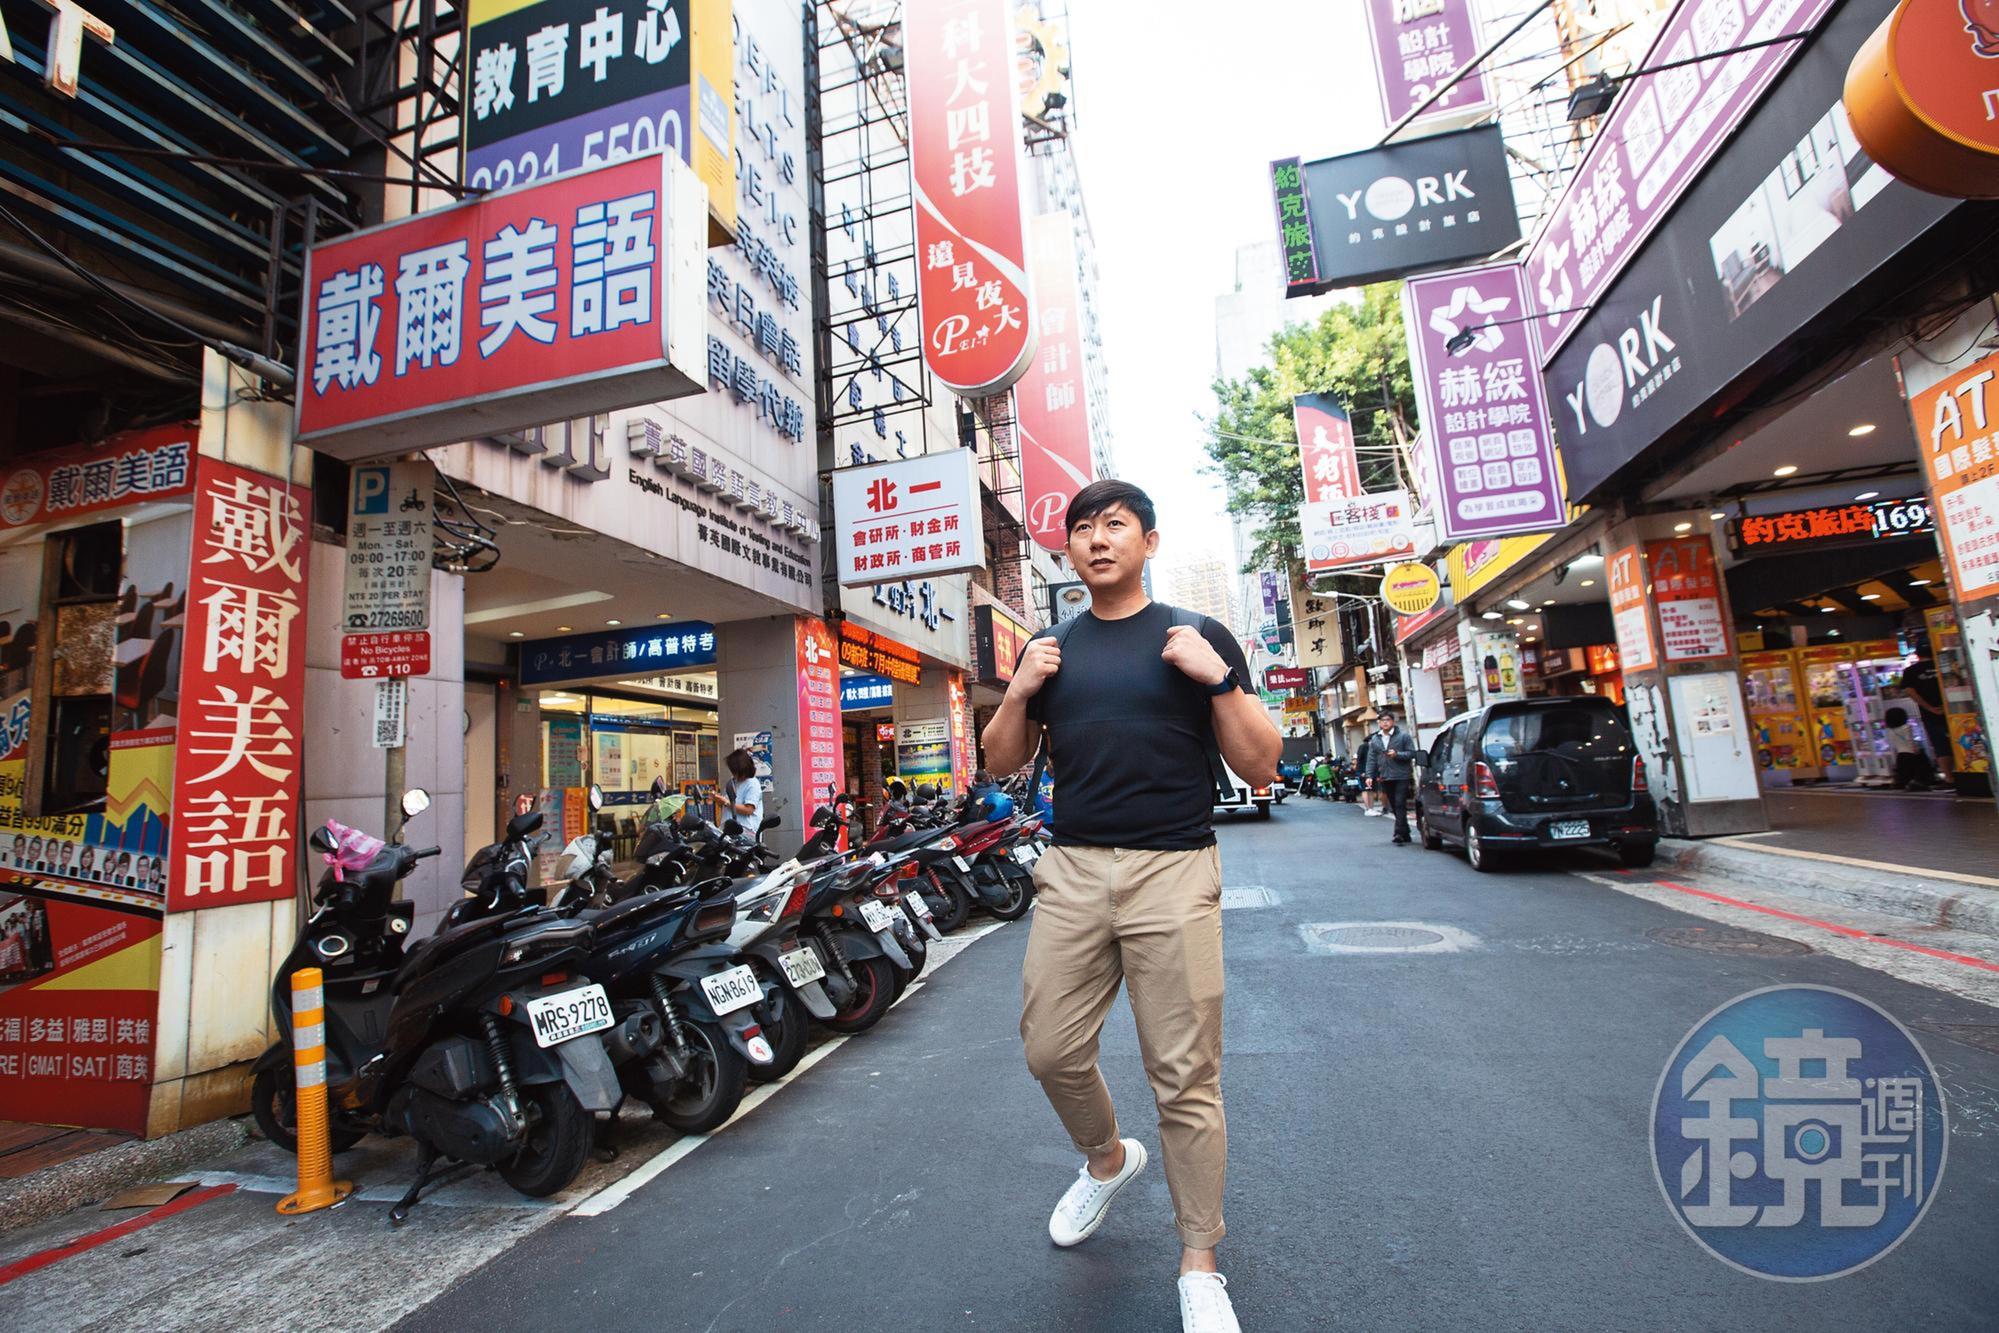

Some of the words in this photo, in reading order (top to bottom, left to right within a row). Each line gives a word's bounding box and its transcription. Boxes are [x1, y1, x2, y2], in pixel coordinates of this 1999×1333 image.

[474, 0, 682, 120] 教育中心
[943, 12, 996, 196] 科大四技
[313, 190, 656, 396] 戴爾美語
[927, 241, 1021, 335] 遠見夜大
[1444, 403, 1533, 434] 設計學院
[1931, 370, 1996, 452] AT
[46, 442, 190, 512] 戴爾美語
[867, 478, 941, 512] 北一
[353, 521, 426, 538] 週一至週六
[629, 468, 663, 497] English
[666, 483, 707, 517] Language
[738, 523, 747, 538] of
[784, 546, 811, 568] Education
[1742, 506, 1875, 544] 約克旅店
[1876, 504, 1934, 532] 169
[382, 591, 399, 599] PER
[403, 590, 424, 599] STAY
[370, 611, 423, 627] 27269600
[375, 645, 410, 655] Bicycles
[805, 635, 831, 664] 北一
[184, 476, 303, 897] 戴爾美語
[387, 664, 410, 675] 110
[30, 1017, 64, 1043] 多益
[73, 1017, 108, 1044] 雅思
[534, 996, 608, 1037] MRS-9278
[29, 1054, 64, 1076] GMAT
[72, 1056, 107, 1078] SAT
